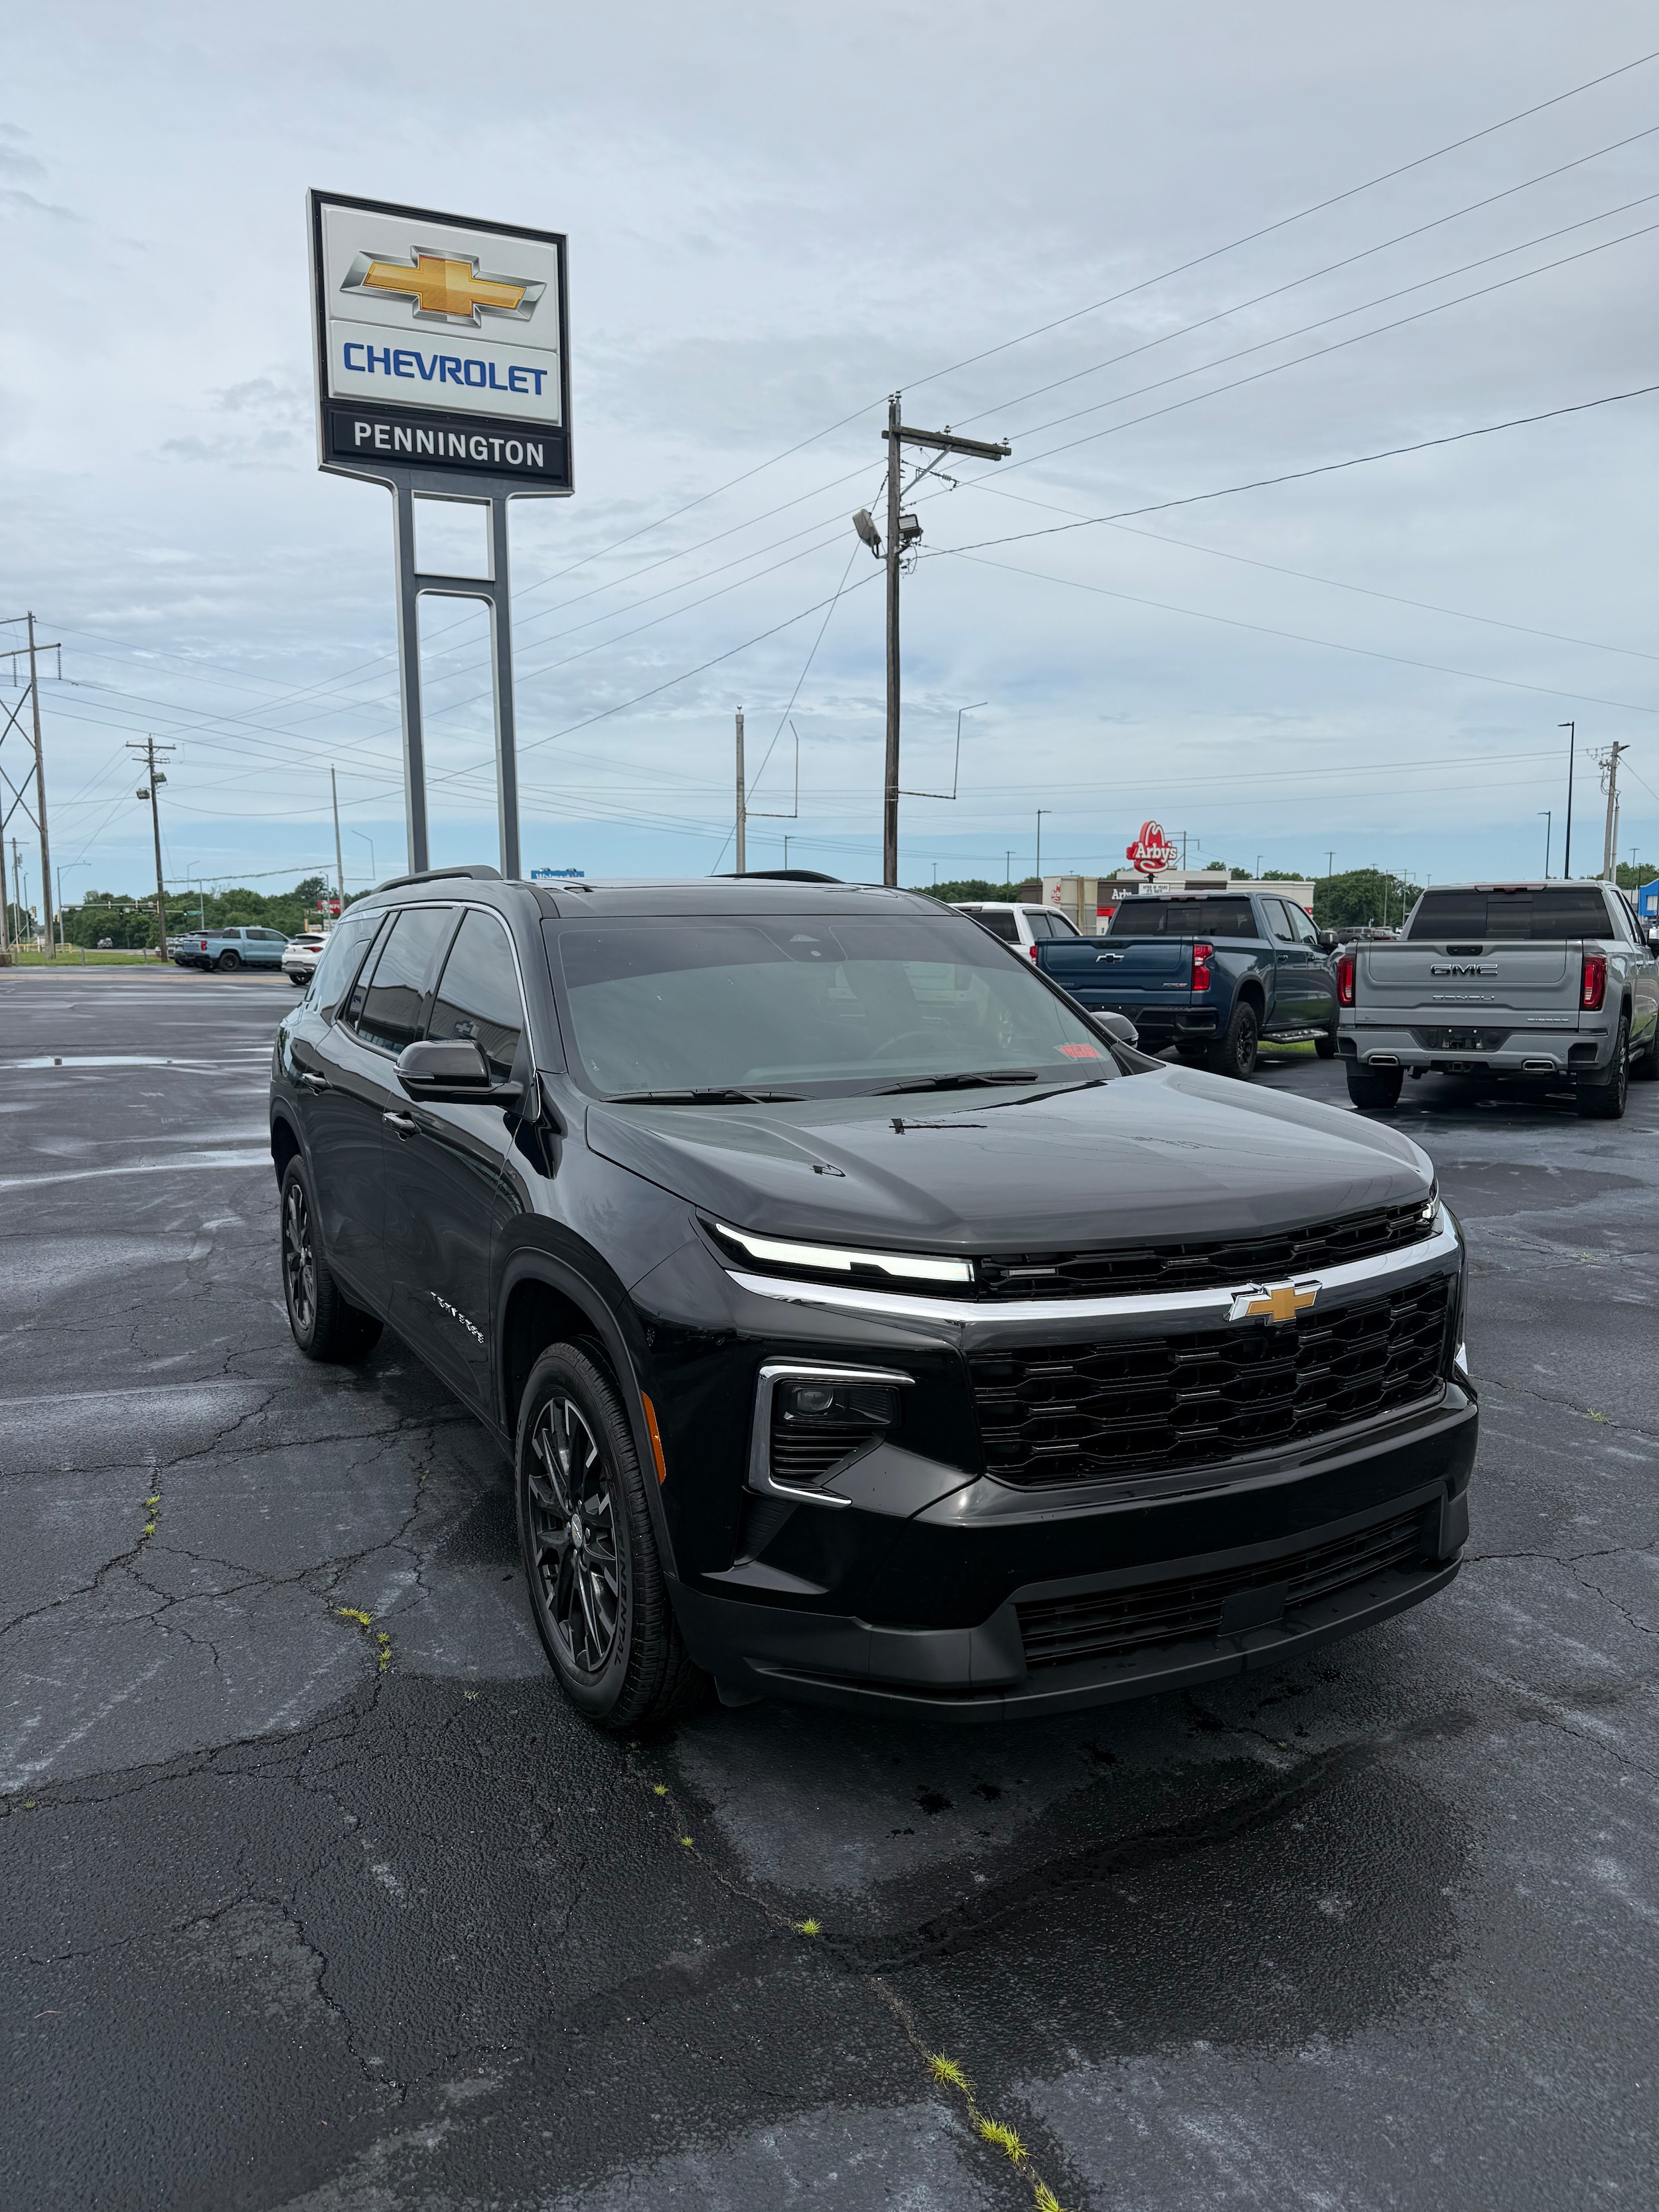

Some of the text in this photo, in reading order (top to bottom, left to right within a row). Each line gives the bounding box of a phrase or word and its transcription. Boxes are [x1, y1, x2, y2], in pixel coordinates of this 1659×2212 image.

[344, 342, 547, 395] CHEVROLET
[354, 421, 544, 467] PENNINGTON
[1135, 842, 1177, 863] Arby's
[1112, 889, 1132, 899] Arb
[1430, 964, 1498, 976] GMC
